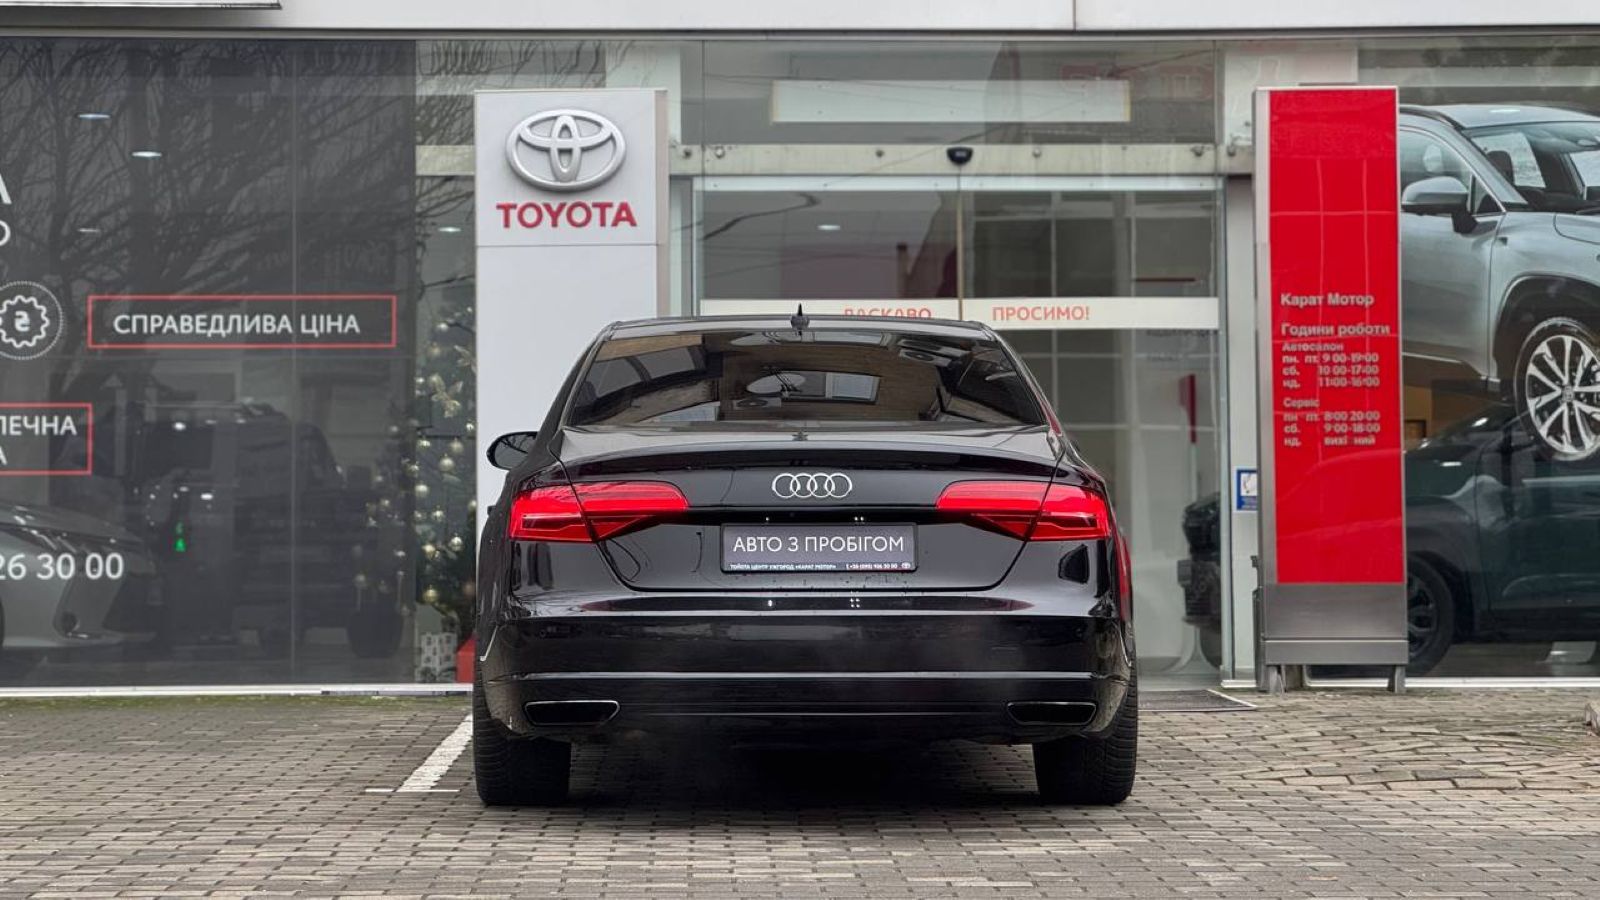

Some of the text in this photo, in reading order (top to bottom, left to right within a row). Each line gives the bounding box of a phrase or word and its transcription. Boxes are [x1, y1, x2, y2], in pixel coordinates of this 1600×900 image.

[496, 201, 637, 229] TOYOTA
[1280, 292, 1375, 308] Карат Мотор
[992, 306, 1090, 321] ПРОСИМО!
[113, 314, 360, 338] СПРАВЕДЛИВА ЦІНА
[1281, 322, 1390, 337] Години роботи
[1281, 342, 1344, 352] Автосалон
[732, 536, 782, 552] АВТО
[805, 536, 904, 552] ПРОБІГОМ
[36, 552, 75, 580] 30
[85, 552, 124, 580] 00
